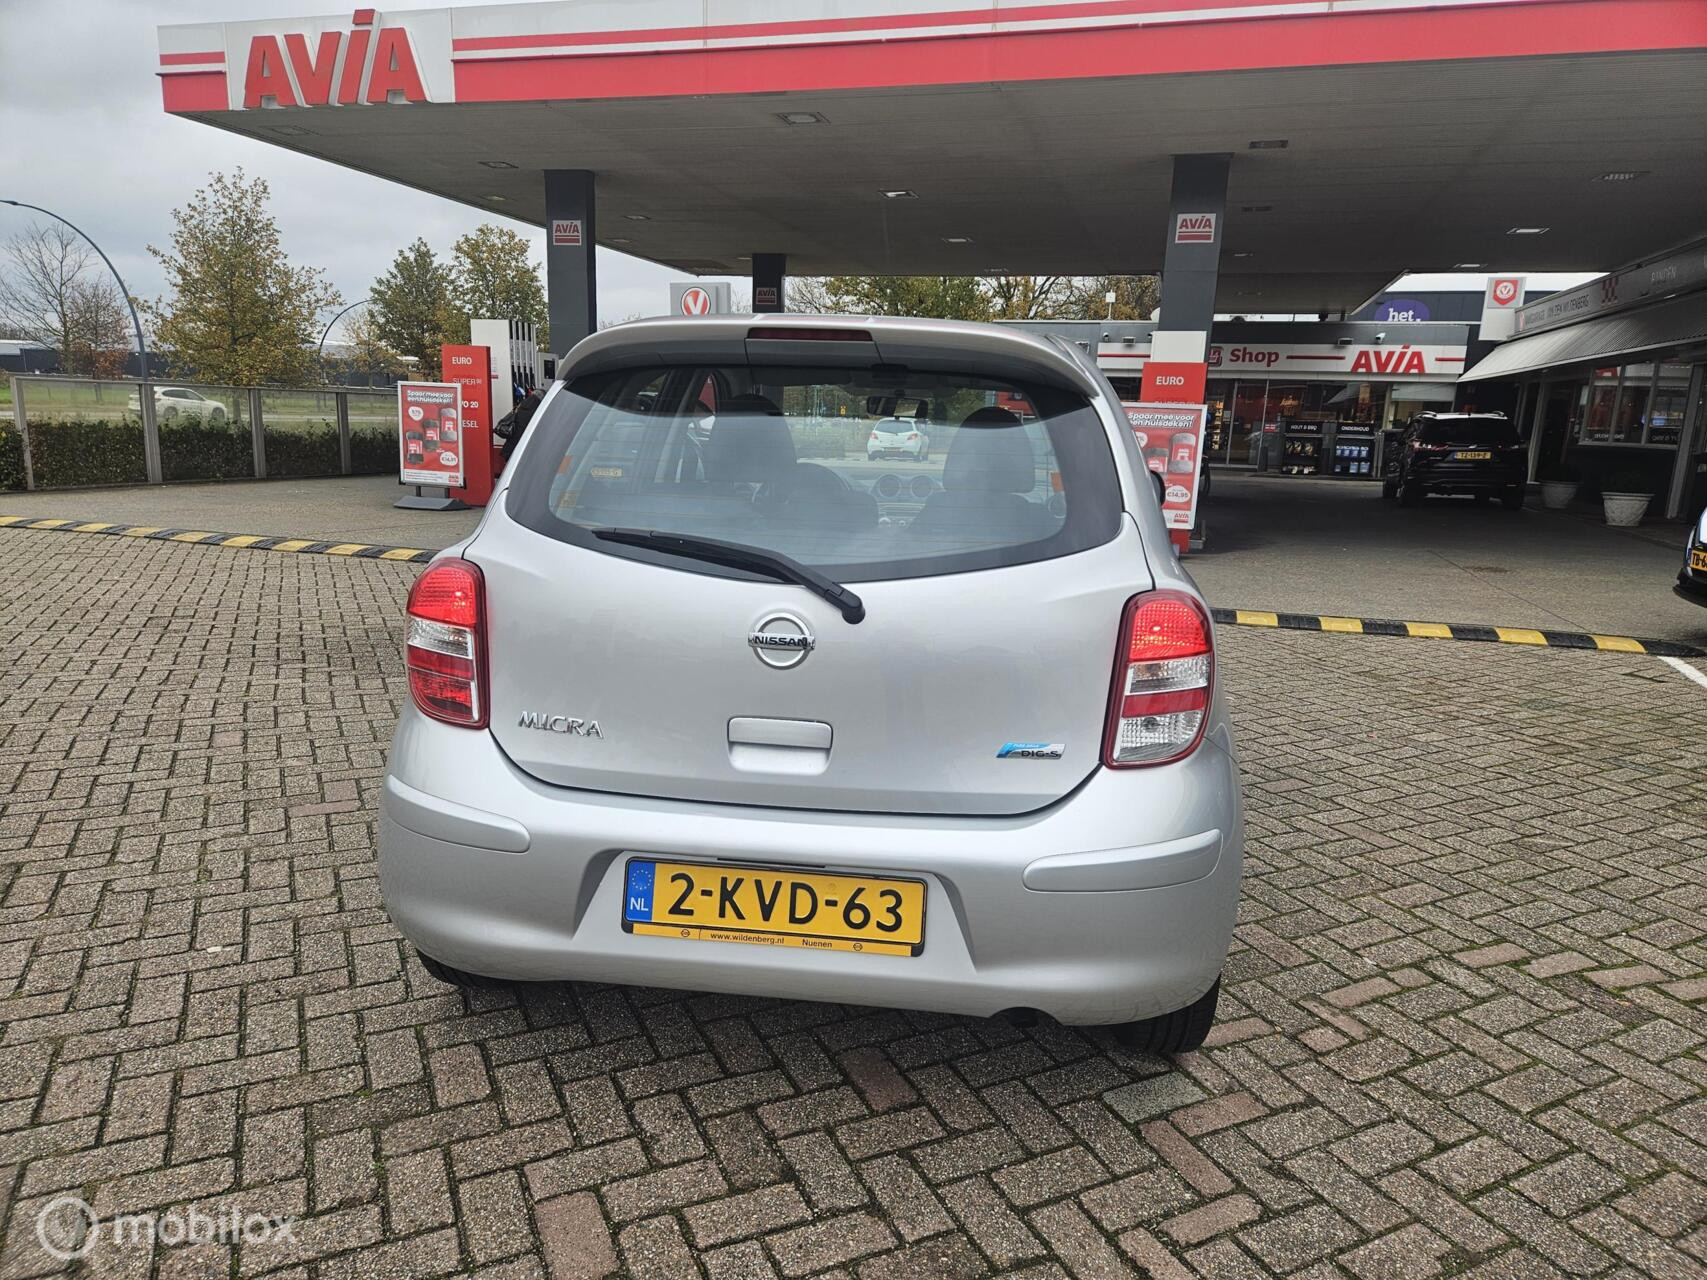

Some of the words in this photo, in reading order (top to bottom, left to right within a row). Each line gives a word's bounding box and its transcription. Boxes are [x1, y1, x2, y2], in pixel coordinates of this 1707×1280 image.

[243, 9, 429, 108] AVIA
[554, 221, 580, 234] AVIA
[1179, 215, 1213, 230] AVIA
[452, 356, 472, 365] EURO
[1229, 347, 1280, 367] Shop
[1350, 344, 1426, 373] AVIA
[1155, 376, 1184, 385] EURO
[462, 420, 479, 428] ESEL
[1128, 412, 1153, 421] Spaar
[1692, 552, 1707, 569] TB-6
[754, 635, 808, 649] NISSAN
[518, 711, 604, 739] MICRA
[1021, 750, 1059, 758] DIG-S
[630, 897, 649, 912] NL
[668, 872, 904, 933] 2-KVD-63
[710, 931, 785, 945] www.wildenberg.nl
[801, 938, 833, 949] Nuenen
